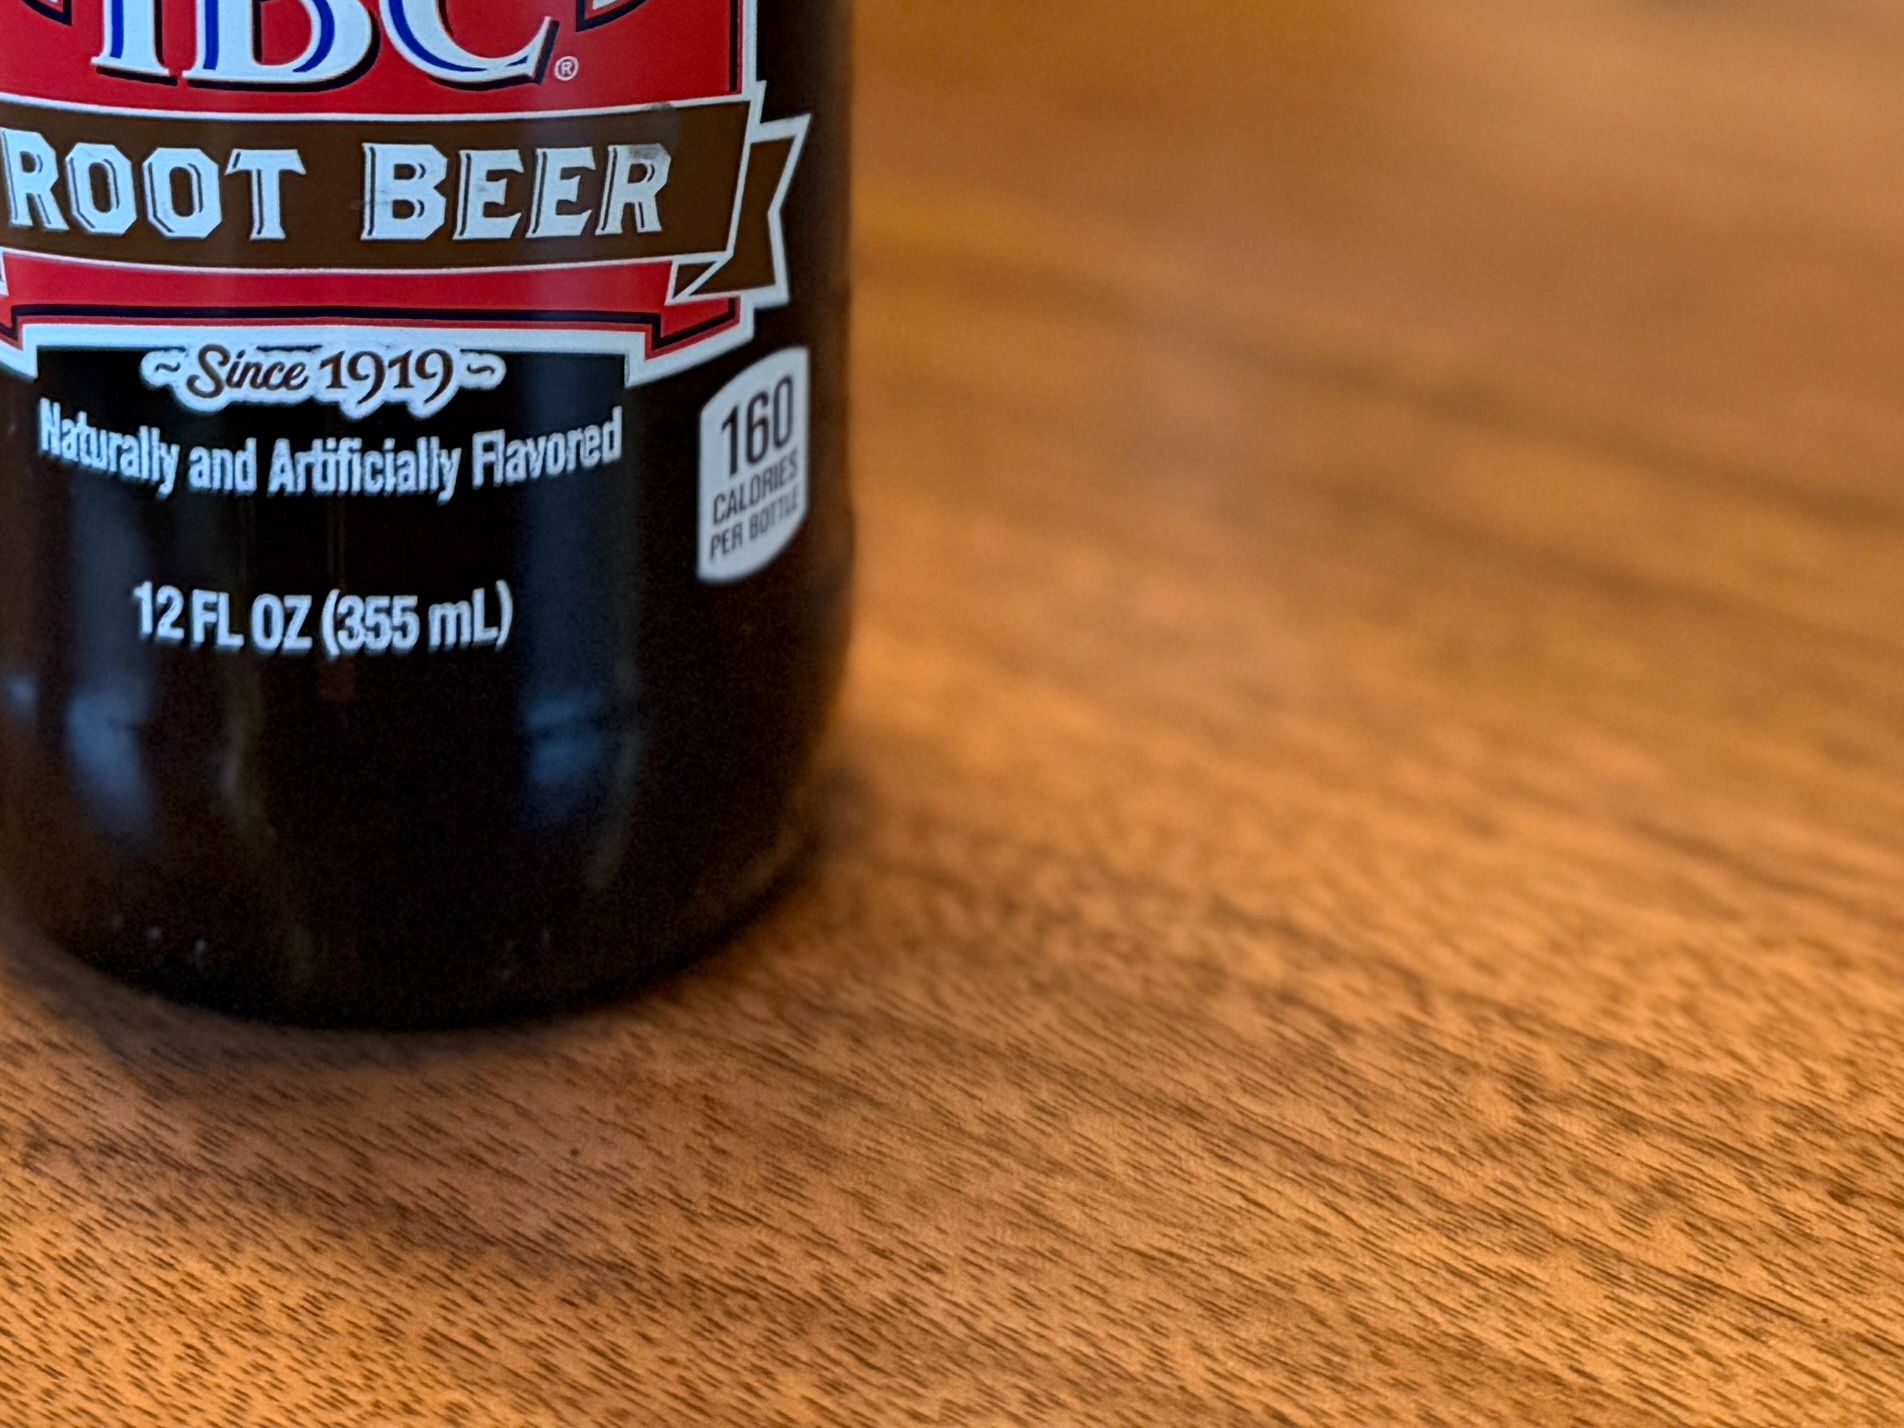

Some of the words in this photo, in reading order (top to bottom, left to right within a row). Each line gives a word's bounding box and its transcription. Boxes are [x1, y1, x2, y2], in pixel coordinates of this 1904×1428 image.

[359, 142, 672, 241] BEER
[185, 343, 310, 399] Since
[318, 347, 454, 406] 1919
[38, 396, 181, 500] Naturally
[188, 436, 258, 494] and
[267, 435, 462, 505] Artificially
[472, 405, 623, 490] Flavored
[720, 373, 794, 477] 160
[709, 525, 743, 561] PER
[749, 487, 799, 540] BOTTLE
[712, 446, 799, 526] CALORIES
[132, 580, 186, 640] 12
[190, 587, 245, 648] FL
[251, 592, 314, 652] OZ
[320, 587, 421, 659] (355
[427, 578, 514, 651] mL)
